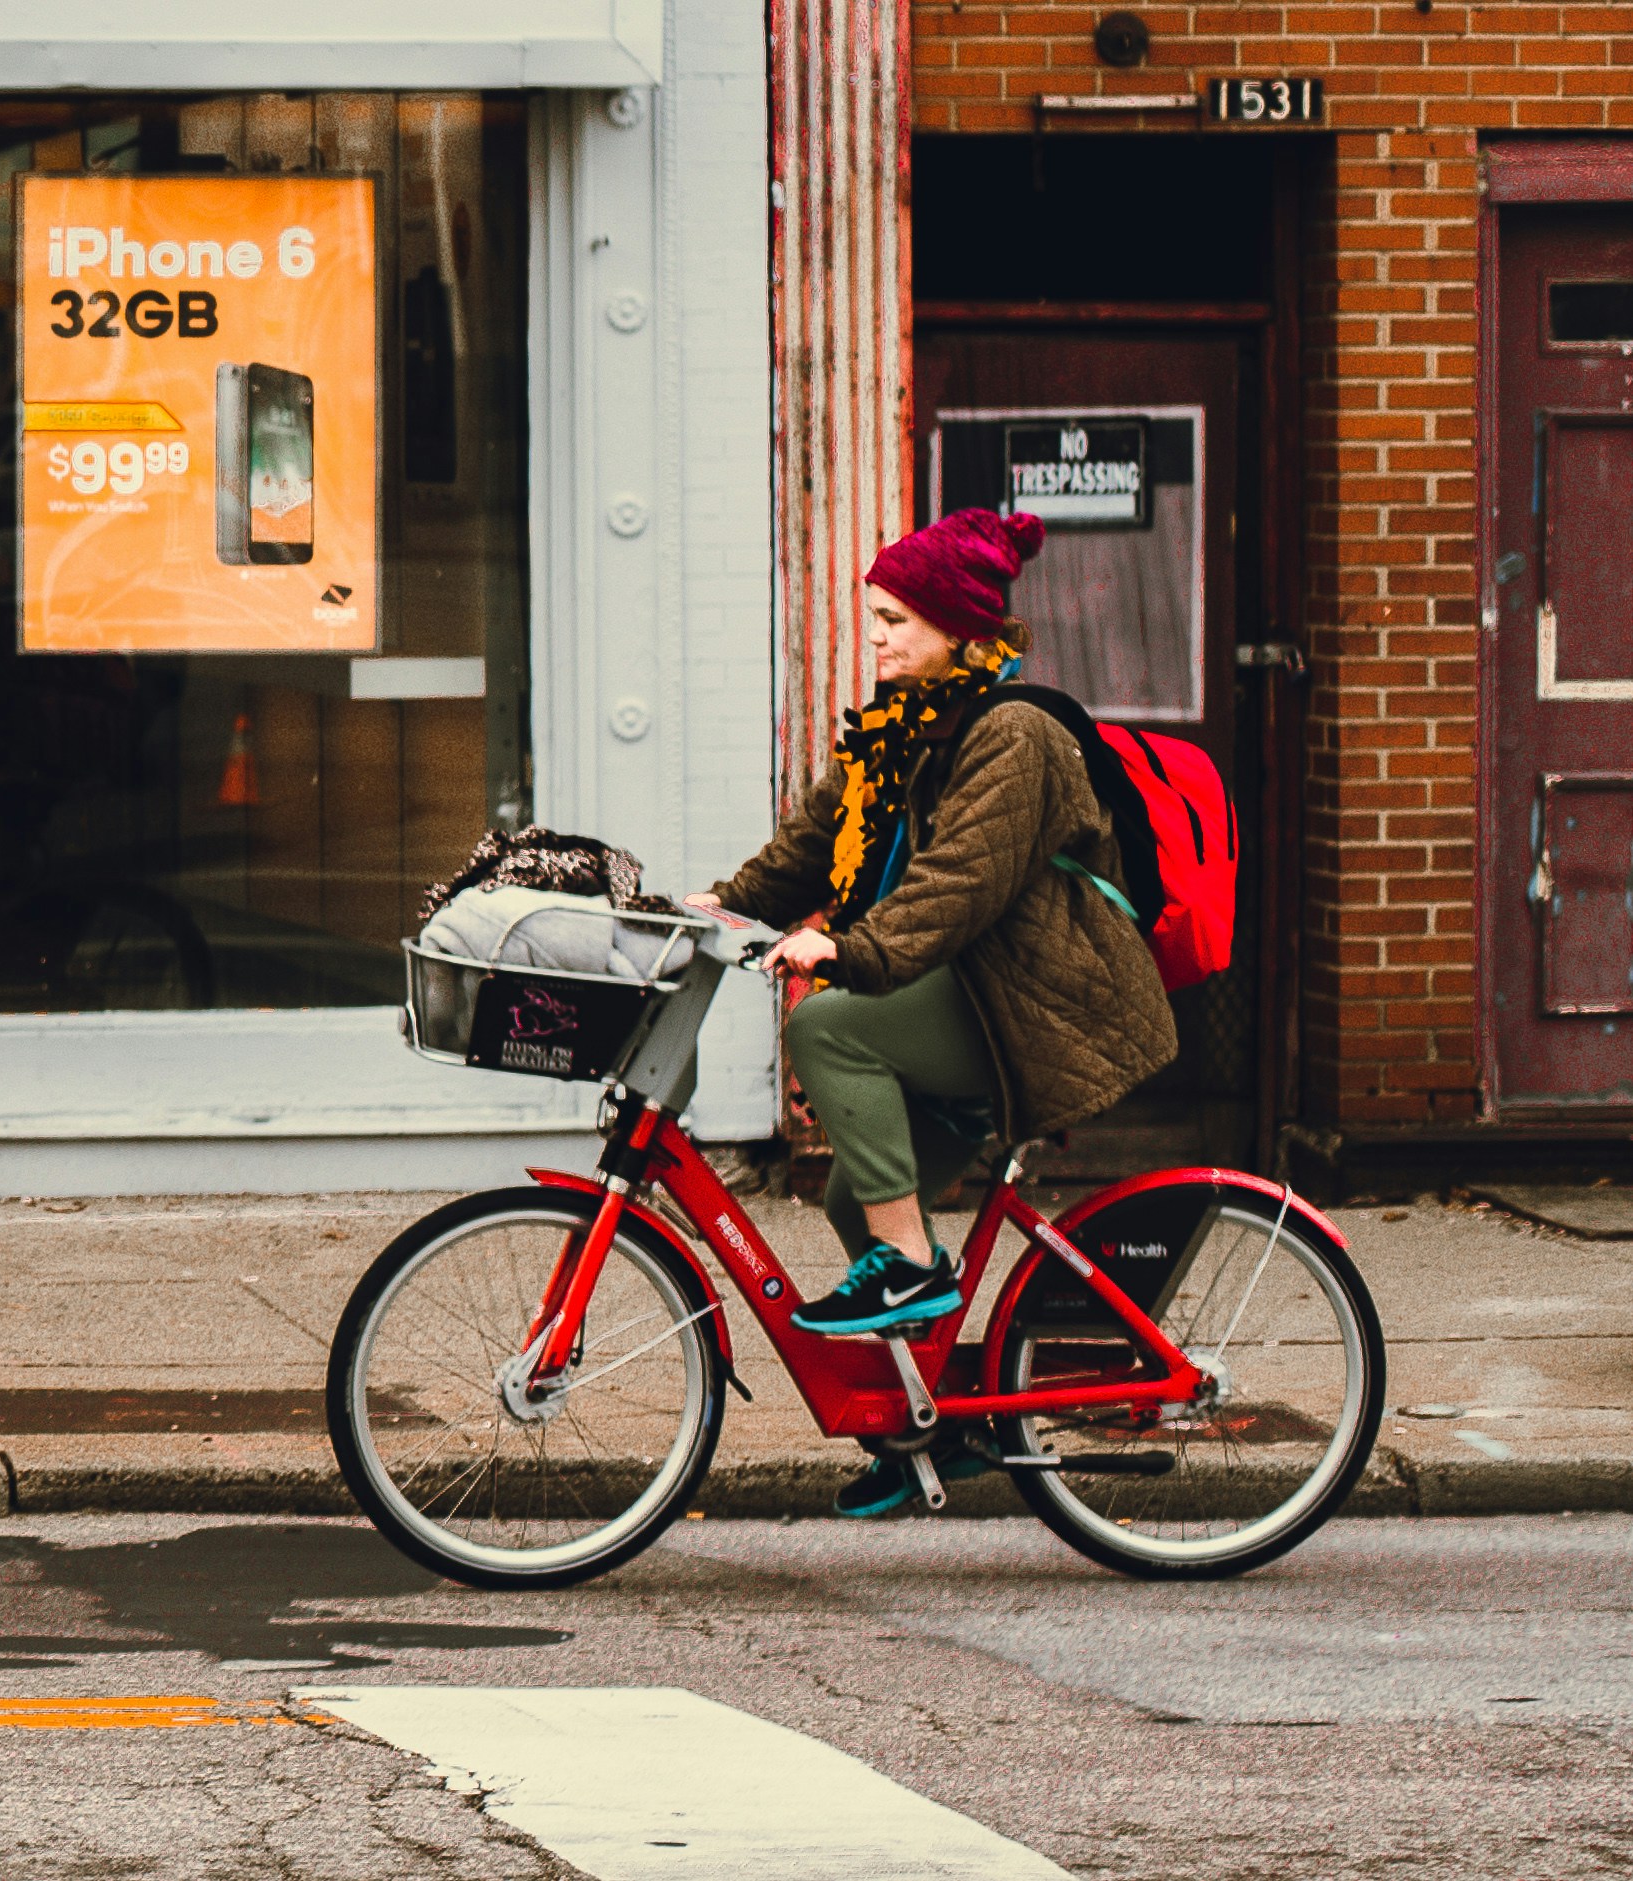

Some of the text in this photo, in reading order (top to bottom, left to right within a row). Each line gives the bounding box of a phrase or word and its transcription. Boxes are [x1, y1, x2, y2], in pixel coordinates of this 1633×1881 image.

[1218, 80, 1314, 121] 1531
[48, 227, 316, 278] iPhone 6
[50, 290, 219, 339] 32GB
[1060, 428, 1089, 460] NO
[1011, 460, 1141, 494] TRESPASSING
[1121, 1241, 1168, 1258] Health
